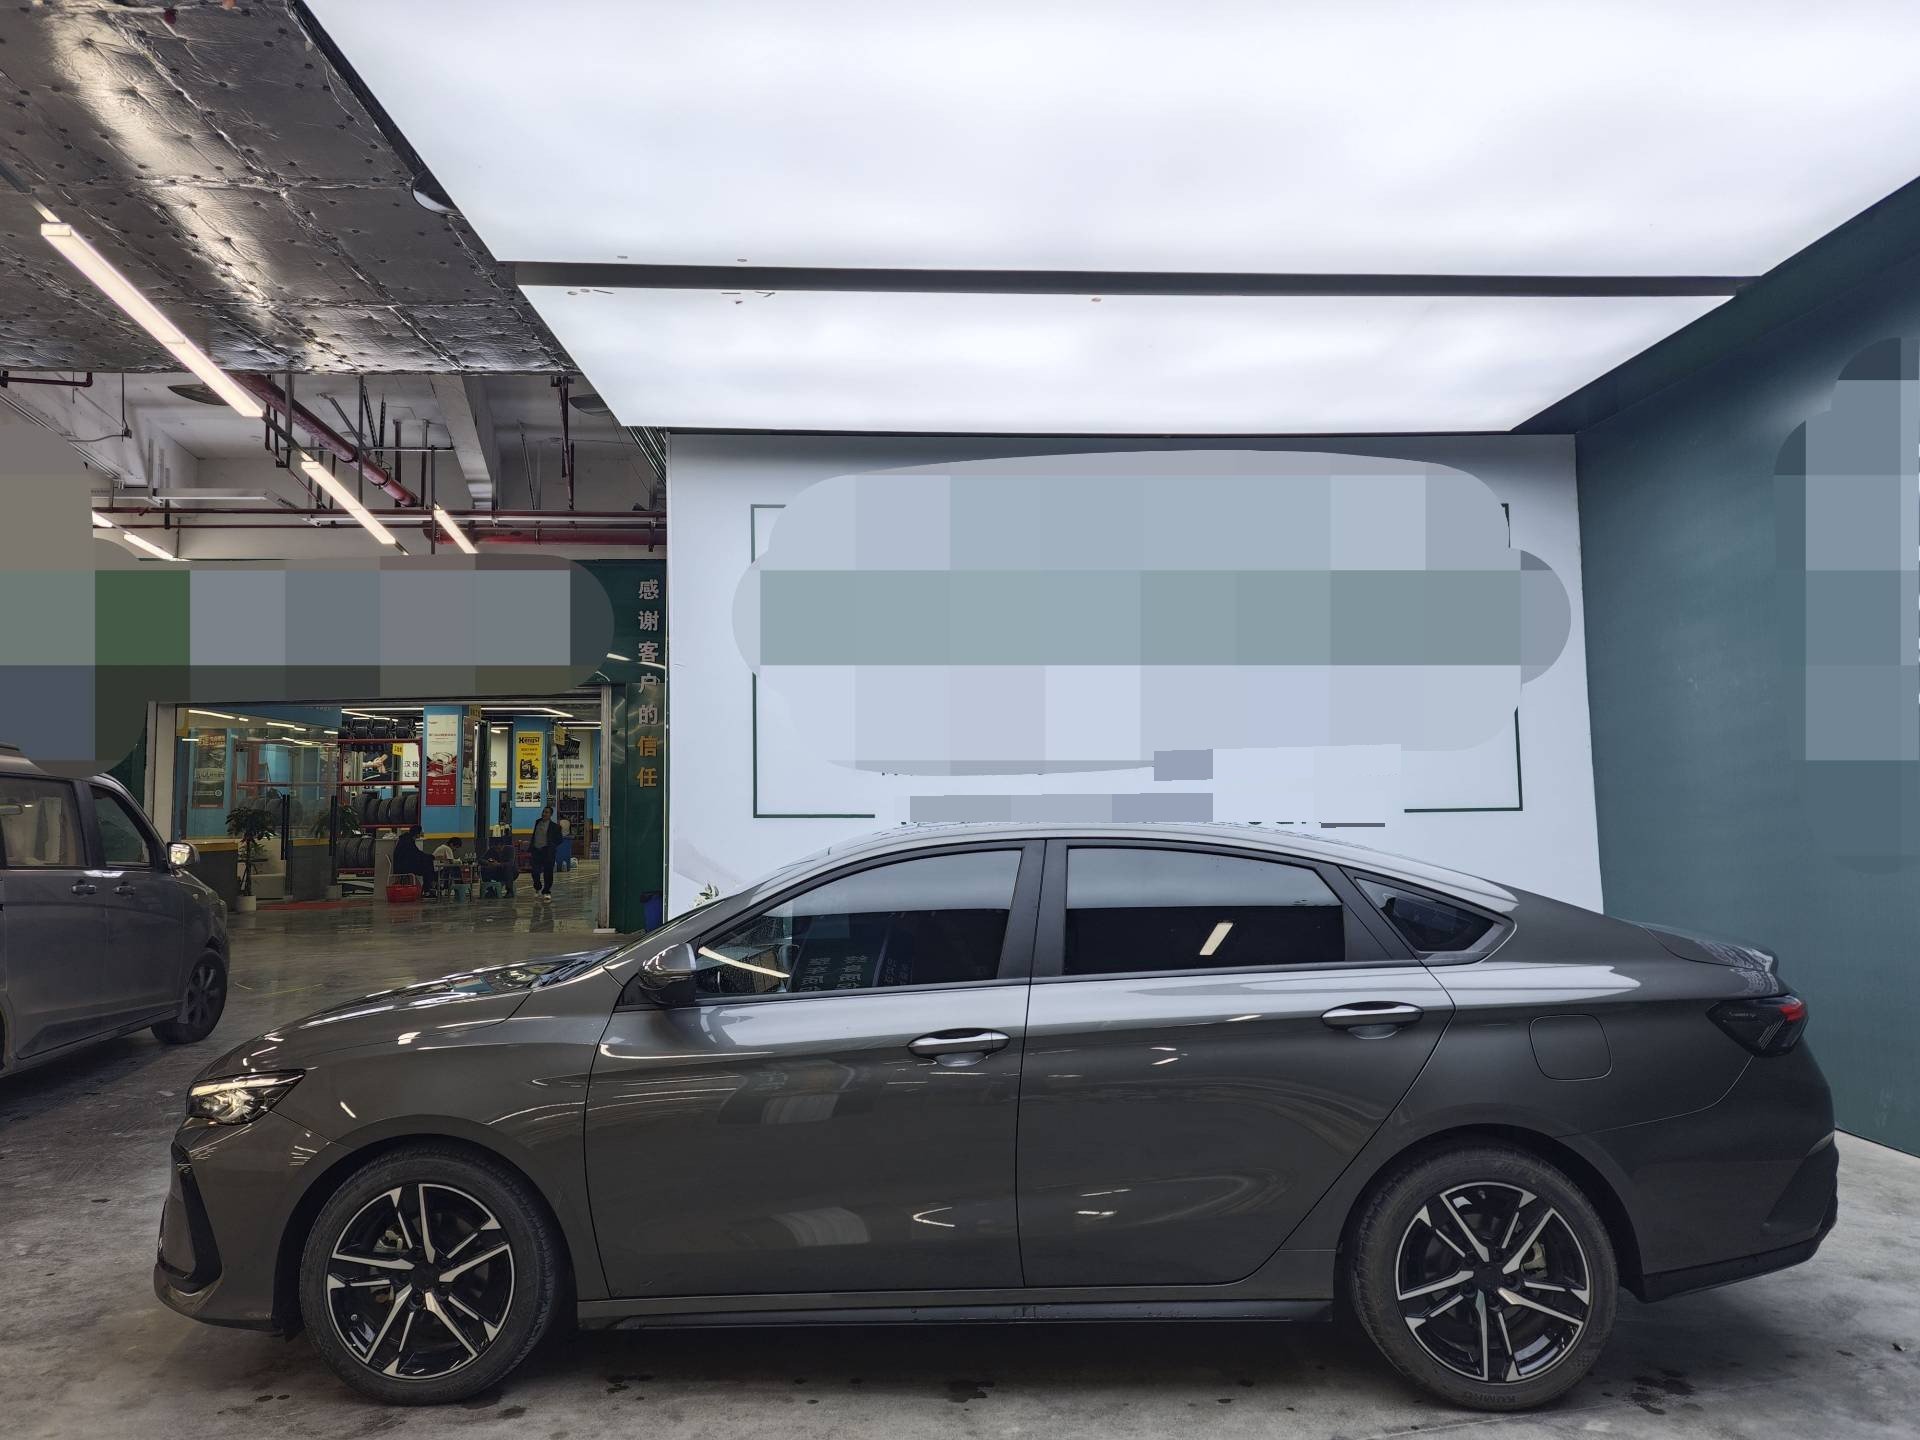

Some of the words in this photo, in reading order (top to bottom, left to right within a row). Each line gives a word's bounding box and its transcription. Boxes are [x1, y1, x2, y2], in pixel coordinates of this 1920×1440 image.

[637, 579, 660, 788] 感谢客户的信任
